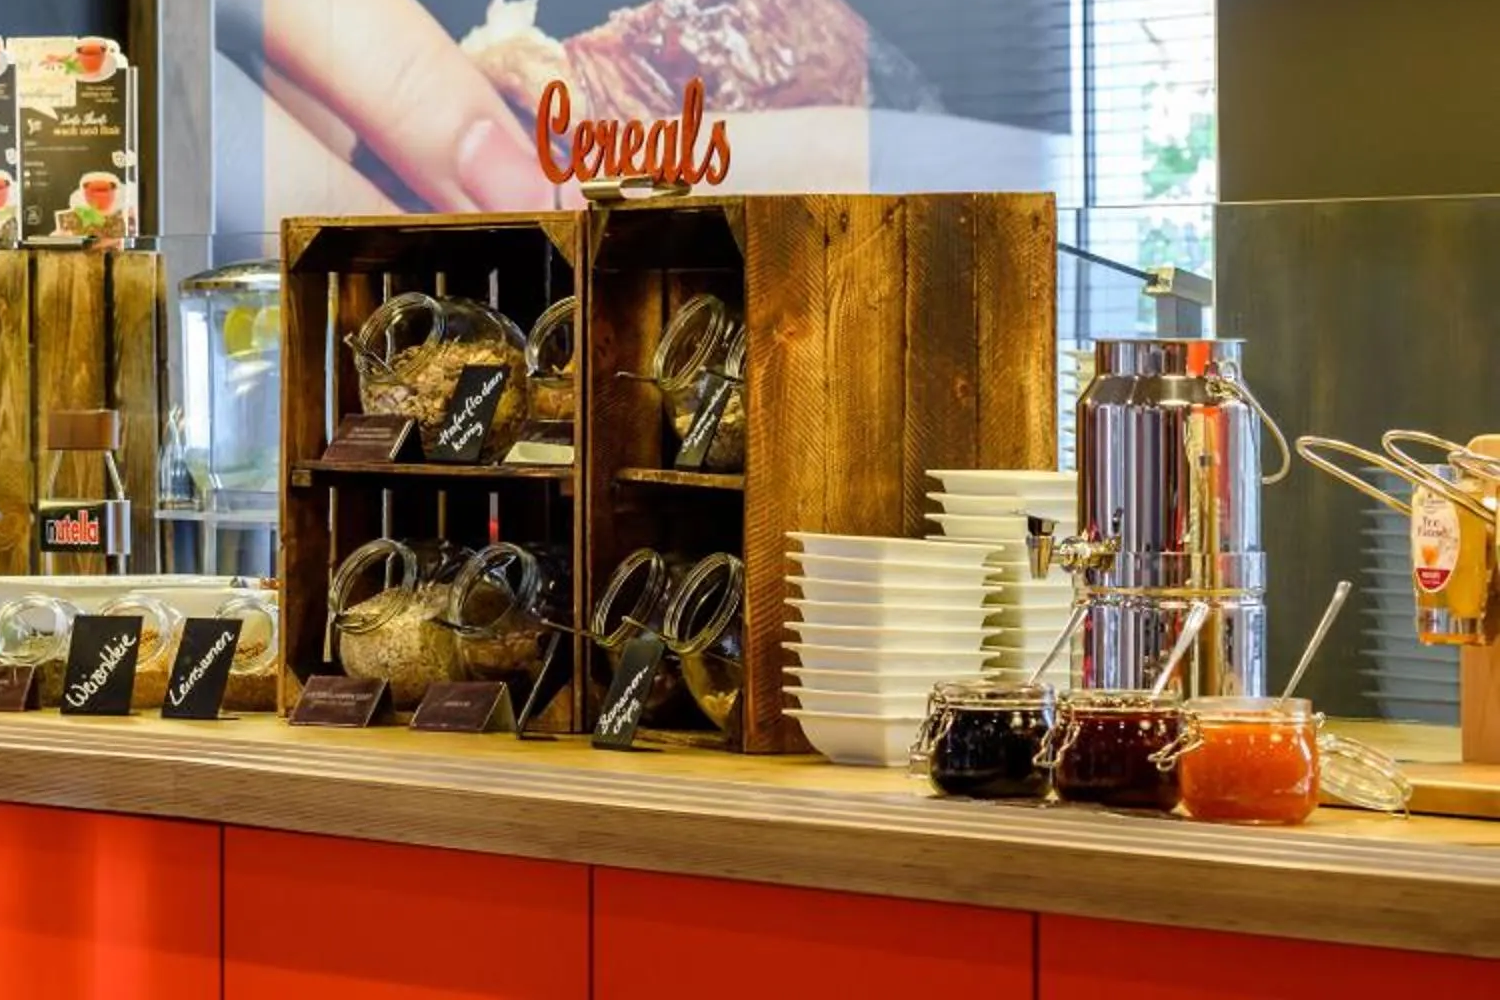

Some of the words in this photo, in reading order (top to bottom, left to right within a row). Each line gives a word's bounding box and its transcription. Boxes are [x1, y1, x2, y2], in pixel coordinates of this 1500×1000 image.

[536, 76, 731, 185] Cereals
[45, 509, 99, 545] nutella
[169, 630, 235, 706] Leinsamen
